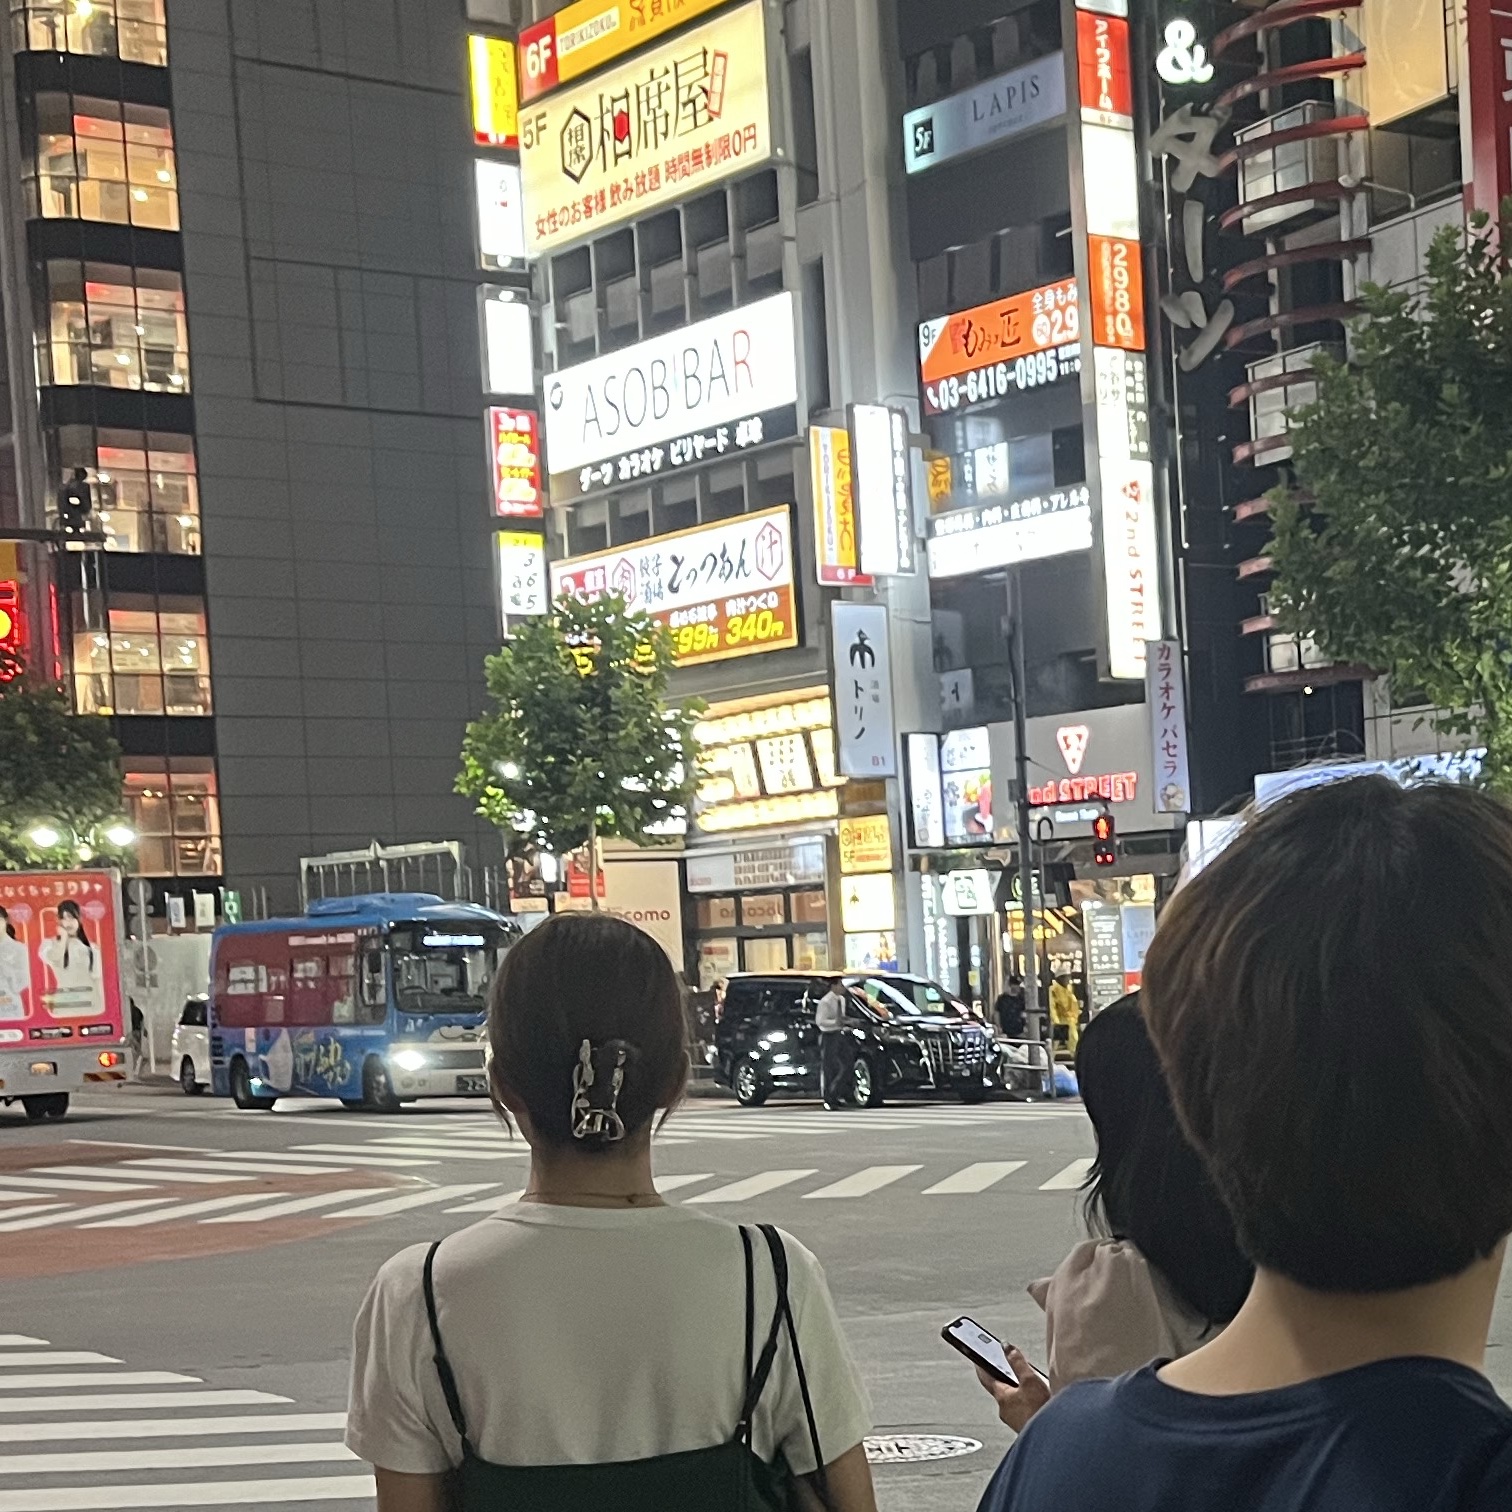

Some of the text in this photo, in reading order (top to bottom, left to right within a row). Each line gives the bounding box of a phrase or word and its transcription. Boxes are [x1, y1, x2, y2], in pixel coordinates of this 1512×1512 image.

[526, 34, 552, 79] 6F
[972, 75, 1040, 121] LAPIS
[523, 112, 547, 149] 5F
[922, 325, 937, 347] 9F
[938, 350, 1058, 411] 03-6416-0995
[1126, 512, 1146, 660] 2nd STREET
[1059, 771, 1137, 803] STREET
